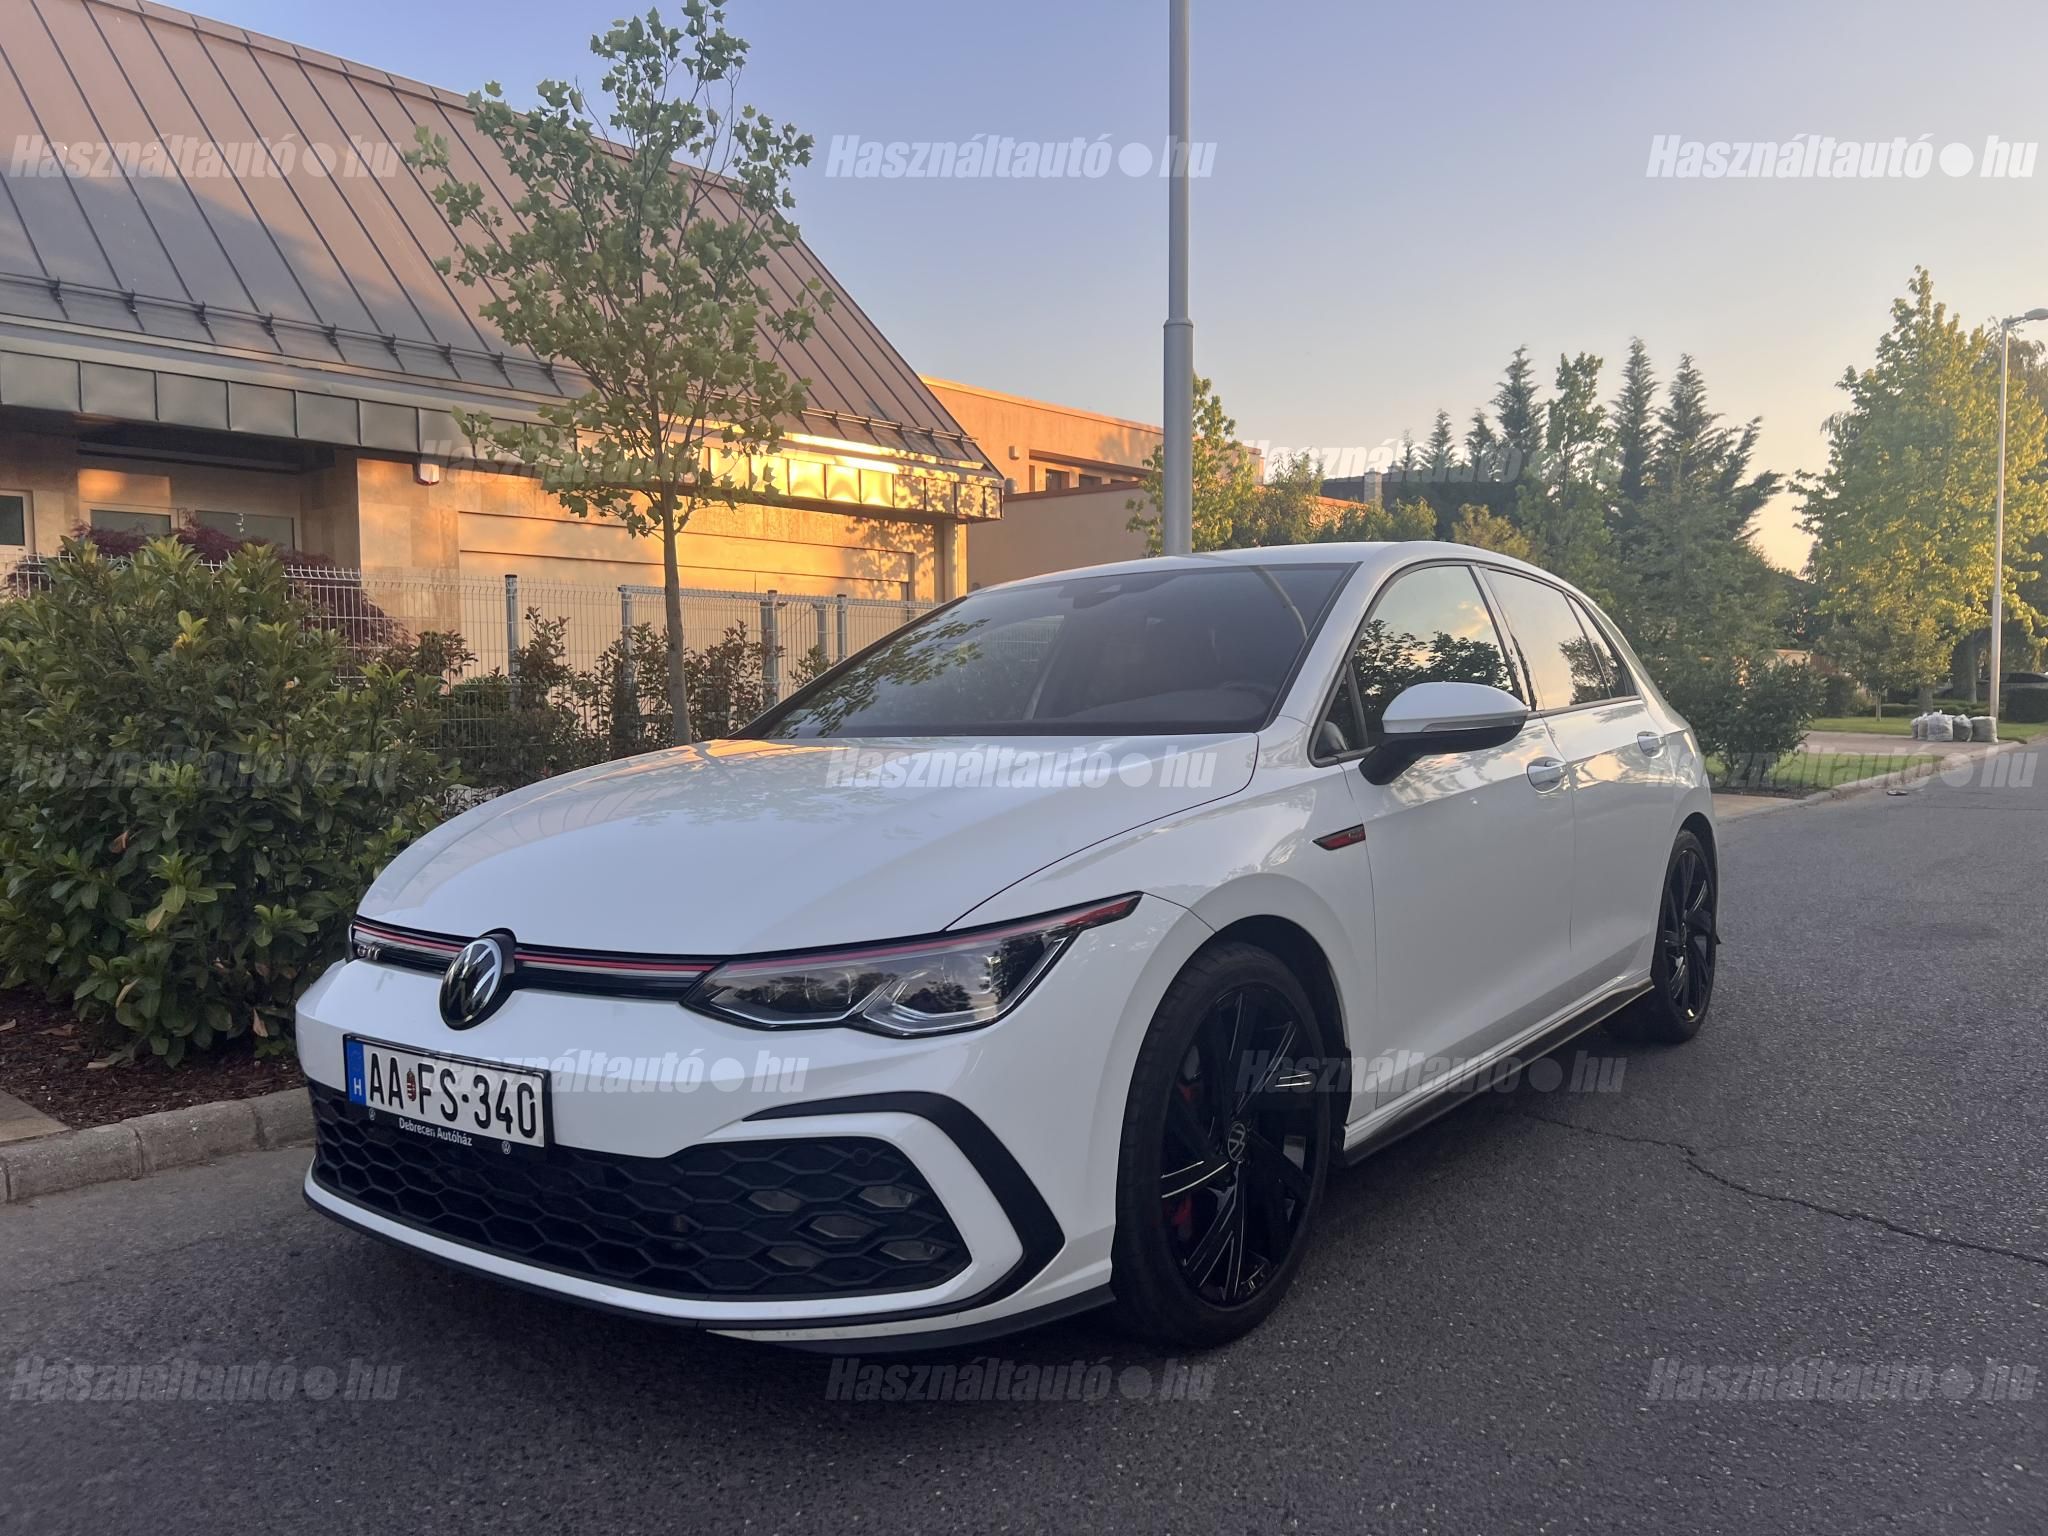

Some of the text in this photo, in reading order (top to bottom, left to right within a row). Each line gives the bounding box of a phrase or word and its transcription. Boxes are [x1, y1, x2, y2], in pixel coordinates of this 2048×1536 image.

[354, 1077, 362, 1096] H
[399, 1117, 472, 1146] Debrecen Autóház
